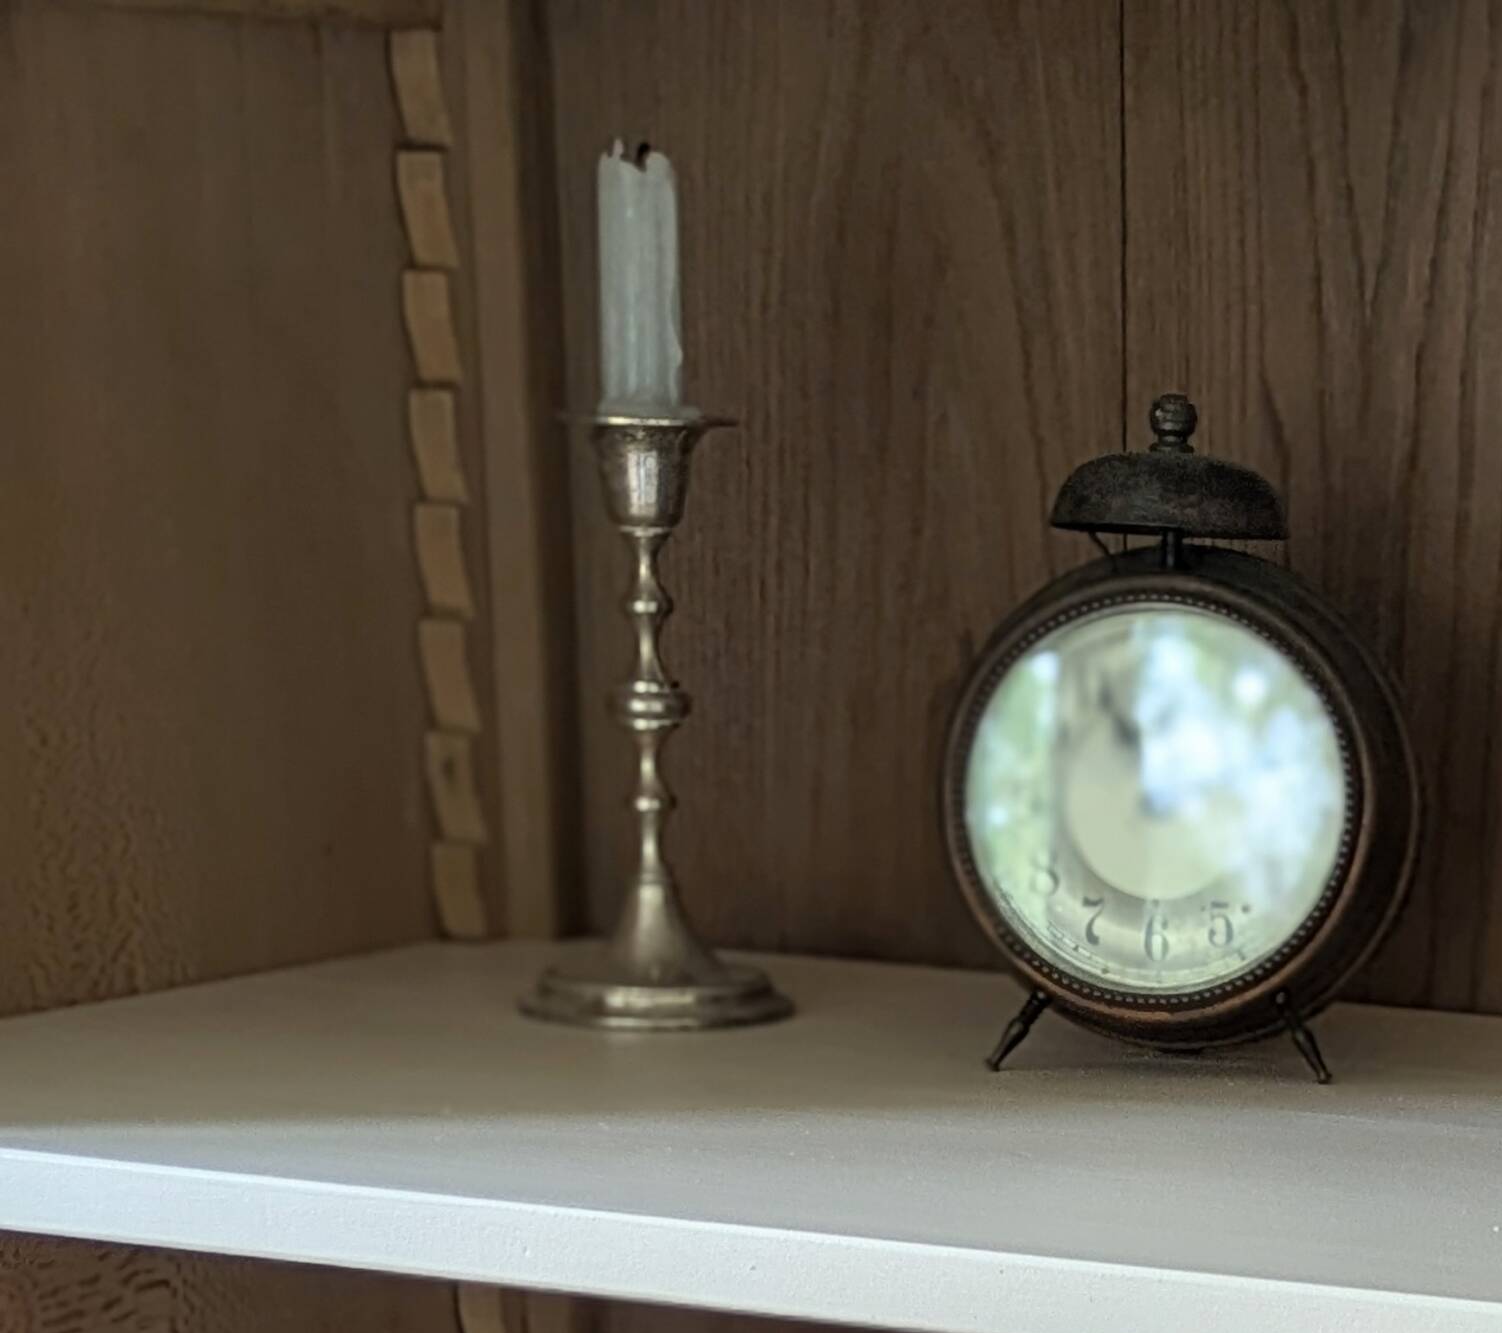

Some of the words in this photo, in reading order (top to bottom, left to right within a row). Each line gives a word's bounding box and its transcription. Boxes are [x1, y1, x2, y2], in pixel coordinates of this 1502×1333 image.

[1082, 896, 1104, 946] 7
[1144, 911, 1170, 962] 6
[1207, 900, 1234, 948] 5
